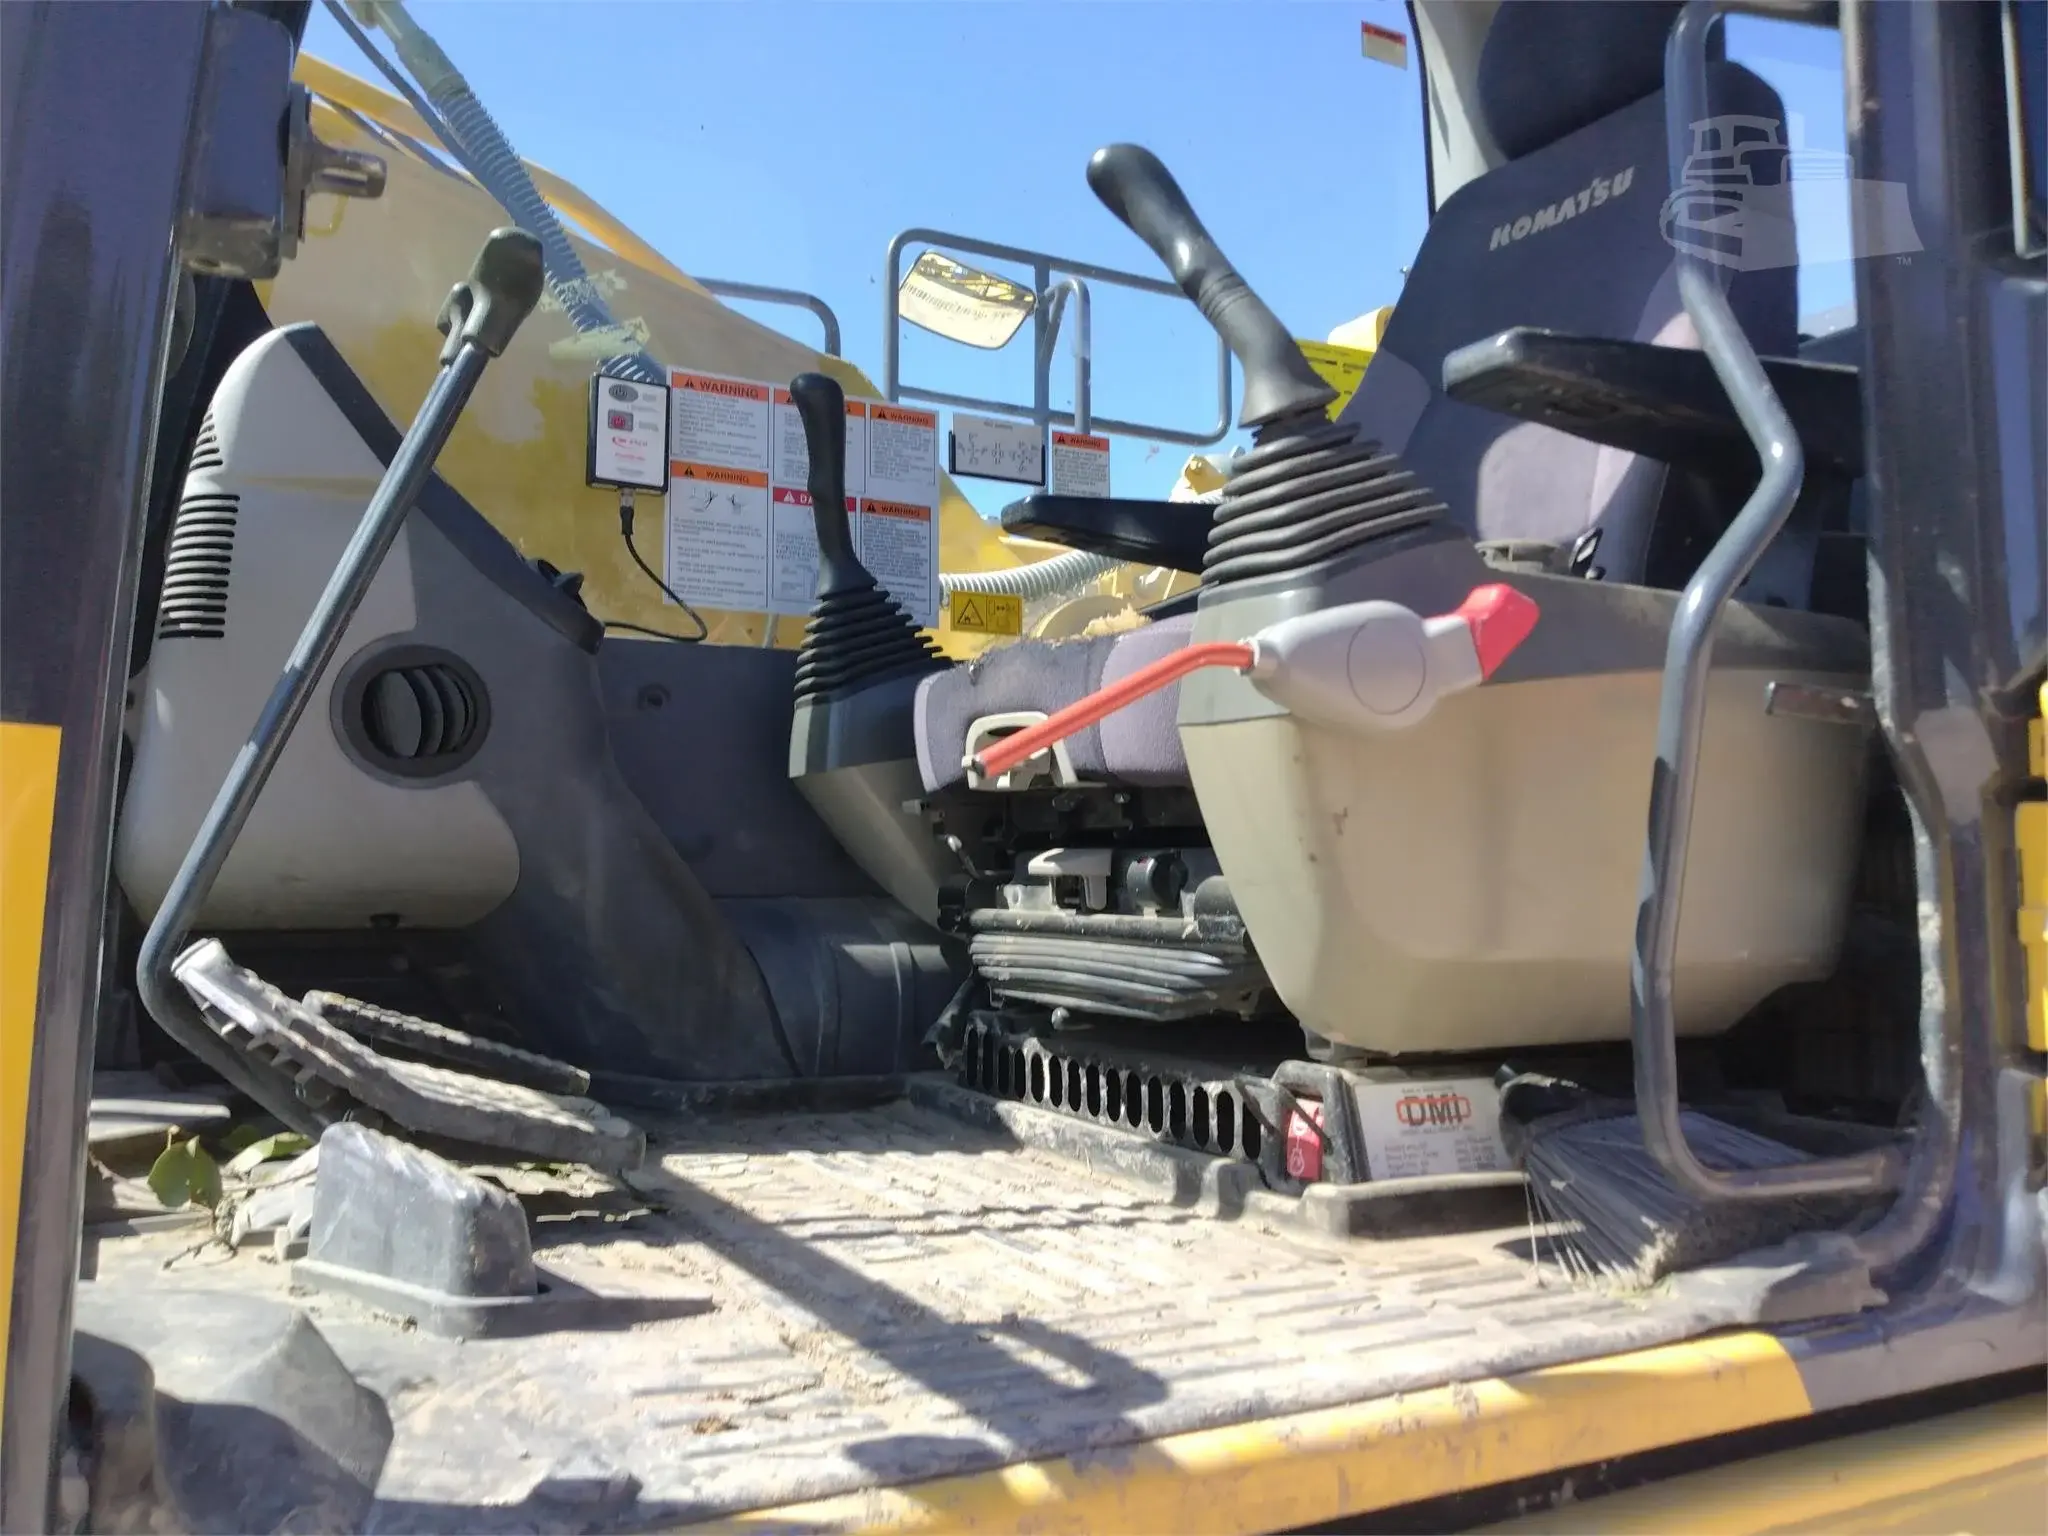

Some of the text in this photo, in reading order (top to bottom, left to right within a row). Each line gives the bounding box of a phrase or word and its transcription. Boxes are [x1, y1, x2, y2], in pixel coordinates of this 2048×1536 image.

[1489, 165, 1635, 252] KOMATSU
[700, 380, 759, 399] WARNING
[890, 411, 929, 426] WARNING
[706, 470, 749, 484] WARNING
[881, 504, 920, 517] WARNING
